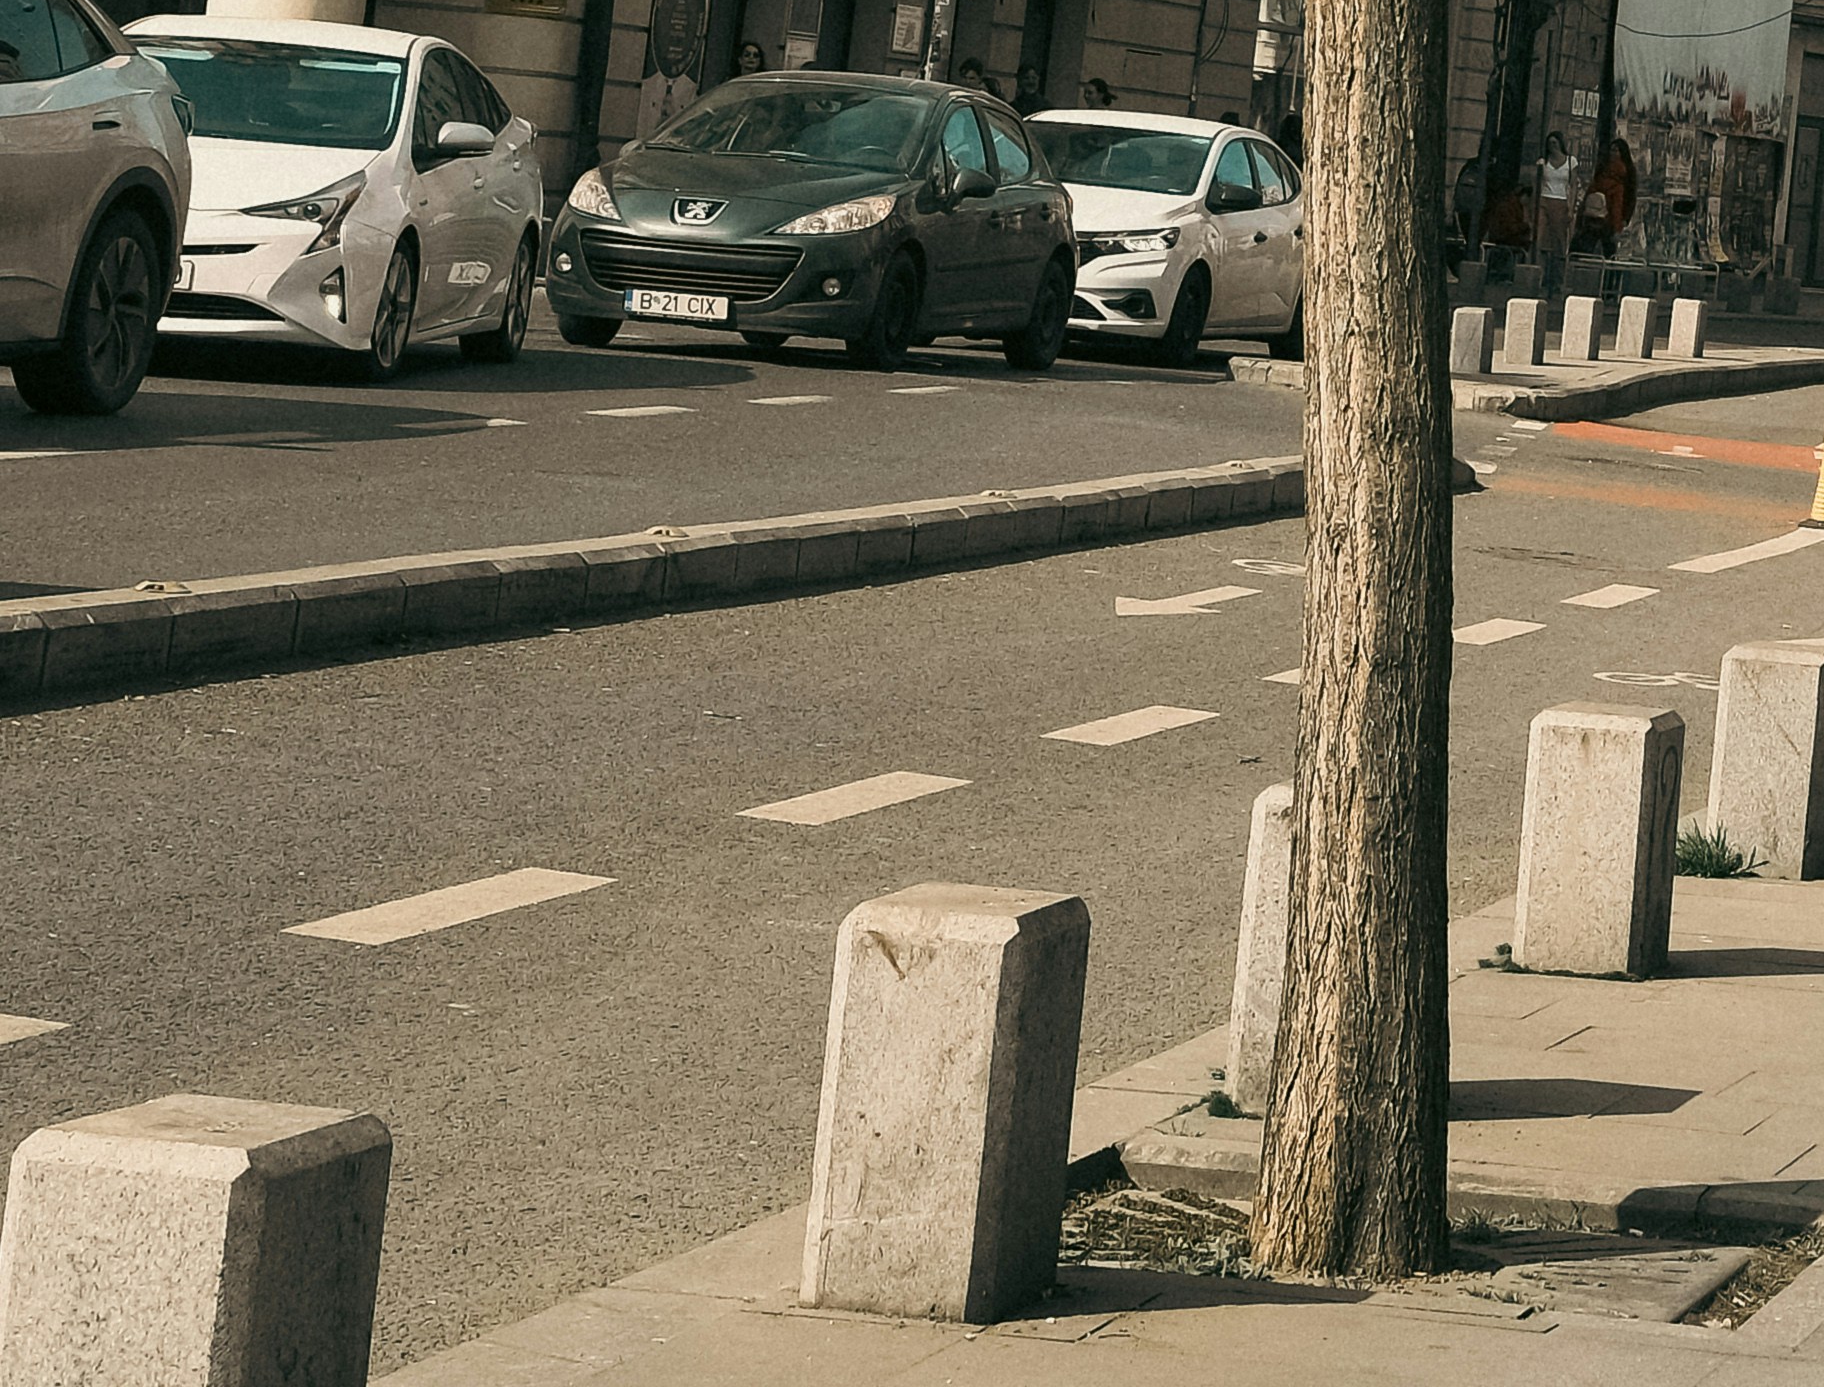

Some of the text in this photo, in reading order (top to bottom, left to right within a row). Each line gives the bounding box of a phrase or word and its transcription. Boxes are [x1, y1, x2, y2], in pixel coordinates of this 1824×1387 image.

[640, 293, 716, 316] B 21 CIX
